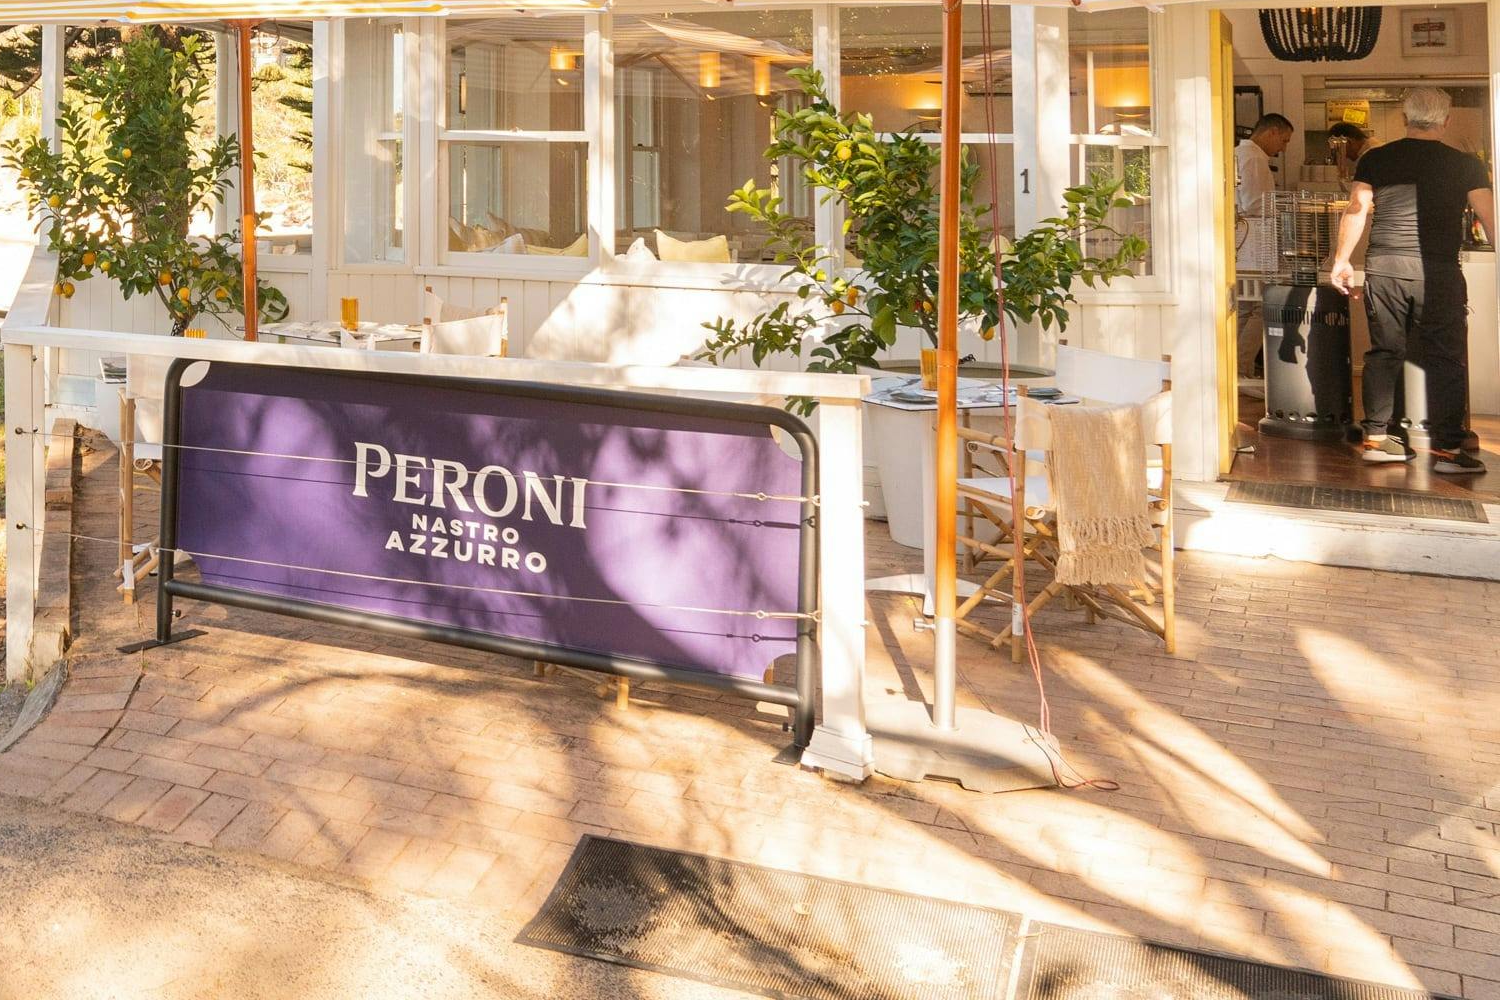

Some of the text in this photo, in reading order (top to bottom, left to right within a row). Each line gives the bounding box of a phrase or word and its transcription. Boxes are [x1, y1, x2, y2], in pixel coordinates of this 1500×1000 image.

[1020, 168, 1030, 194] 1
[352, 441, 589, 529] PERONI
[412, 513, 519, 545] NASTRO
[385, 531, 547, 573] AZZURRO
